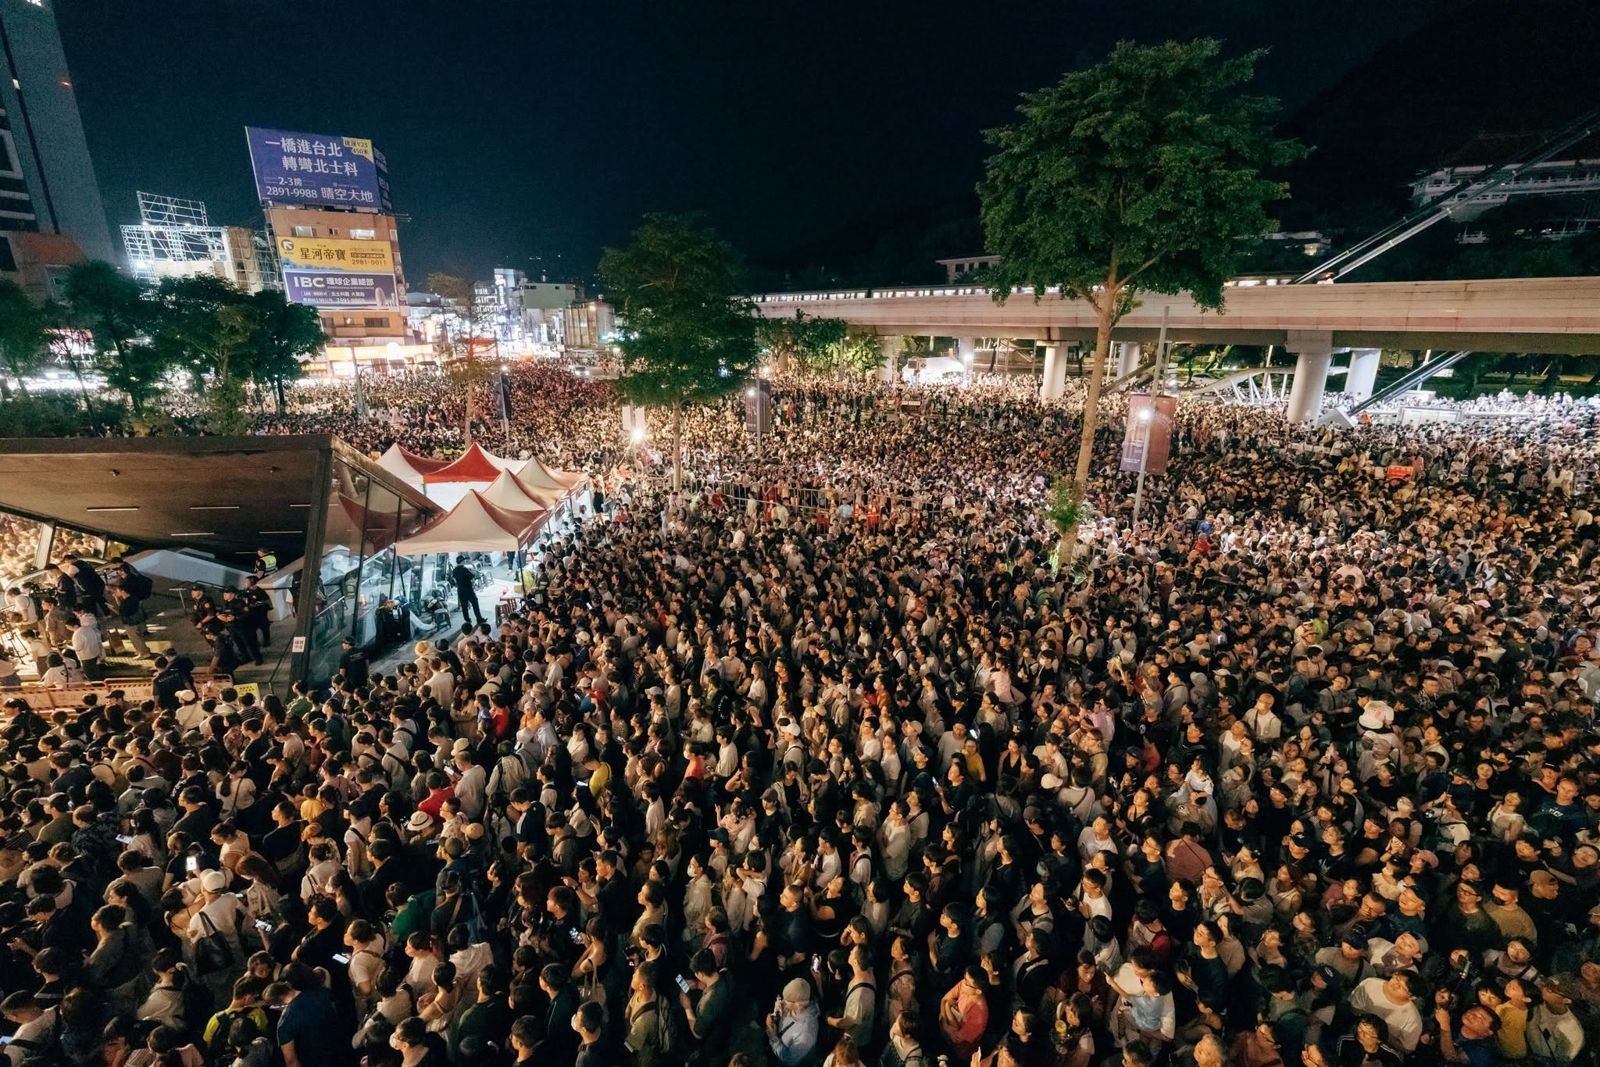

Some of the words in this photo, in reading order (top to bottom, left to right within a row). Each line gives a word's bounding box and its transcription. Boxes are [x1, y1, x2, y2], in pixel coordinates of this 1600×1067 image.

[265, 137, 343, 157] 一橋進台北
[282, 156, 358, 176] 轉彎北士科
[266, 186, 318, 198] 2891-9988
[321, 187, 374, 203] 晴空大地
[300, 247, 346, 261] 星河帝寶
[293, 276, 325, 288] IBC
